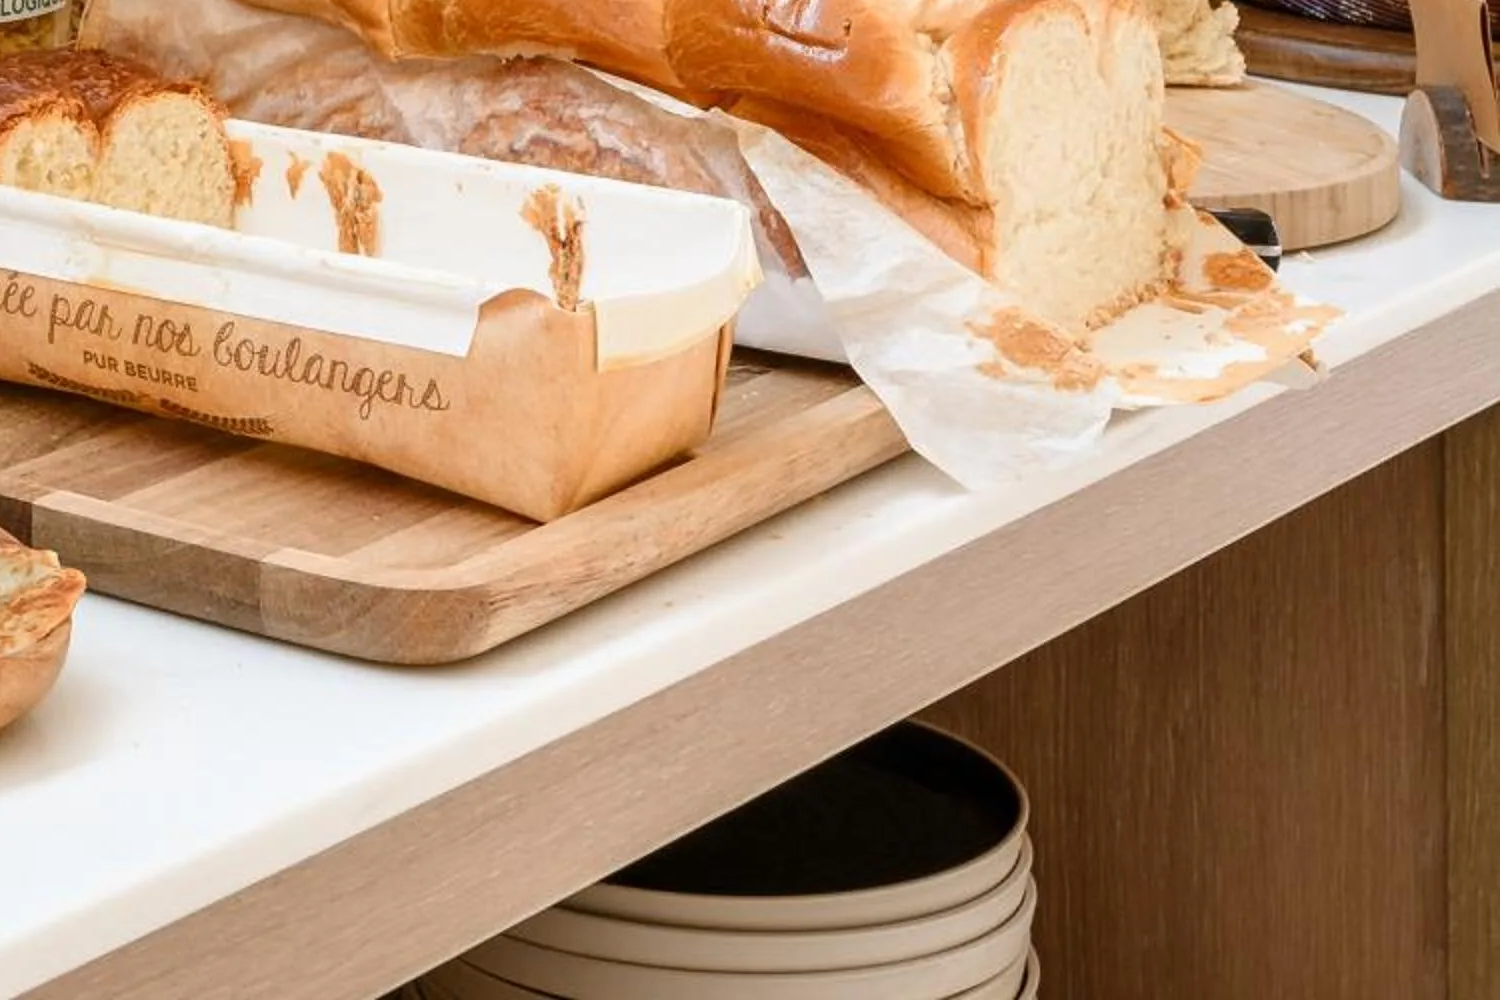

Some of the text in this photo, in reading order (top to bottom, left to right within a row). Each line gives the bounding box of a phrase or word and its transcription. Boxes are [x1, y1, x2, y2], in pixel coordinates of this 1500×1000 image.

[47, 293, 123, 345] par
[132, 311, 202, 357] nos
[213, 320, 451, 421] boulangers
[83, 350, 200, 393] PUR BEURRE
